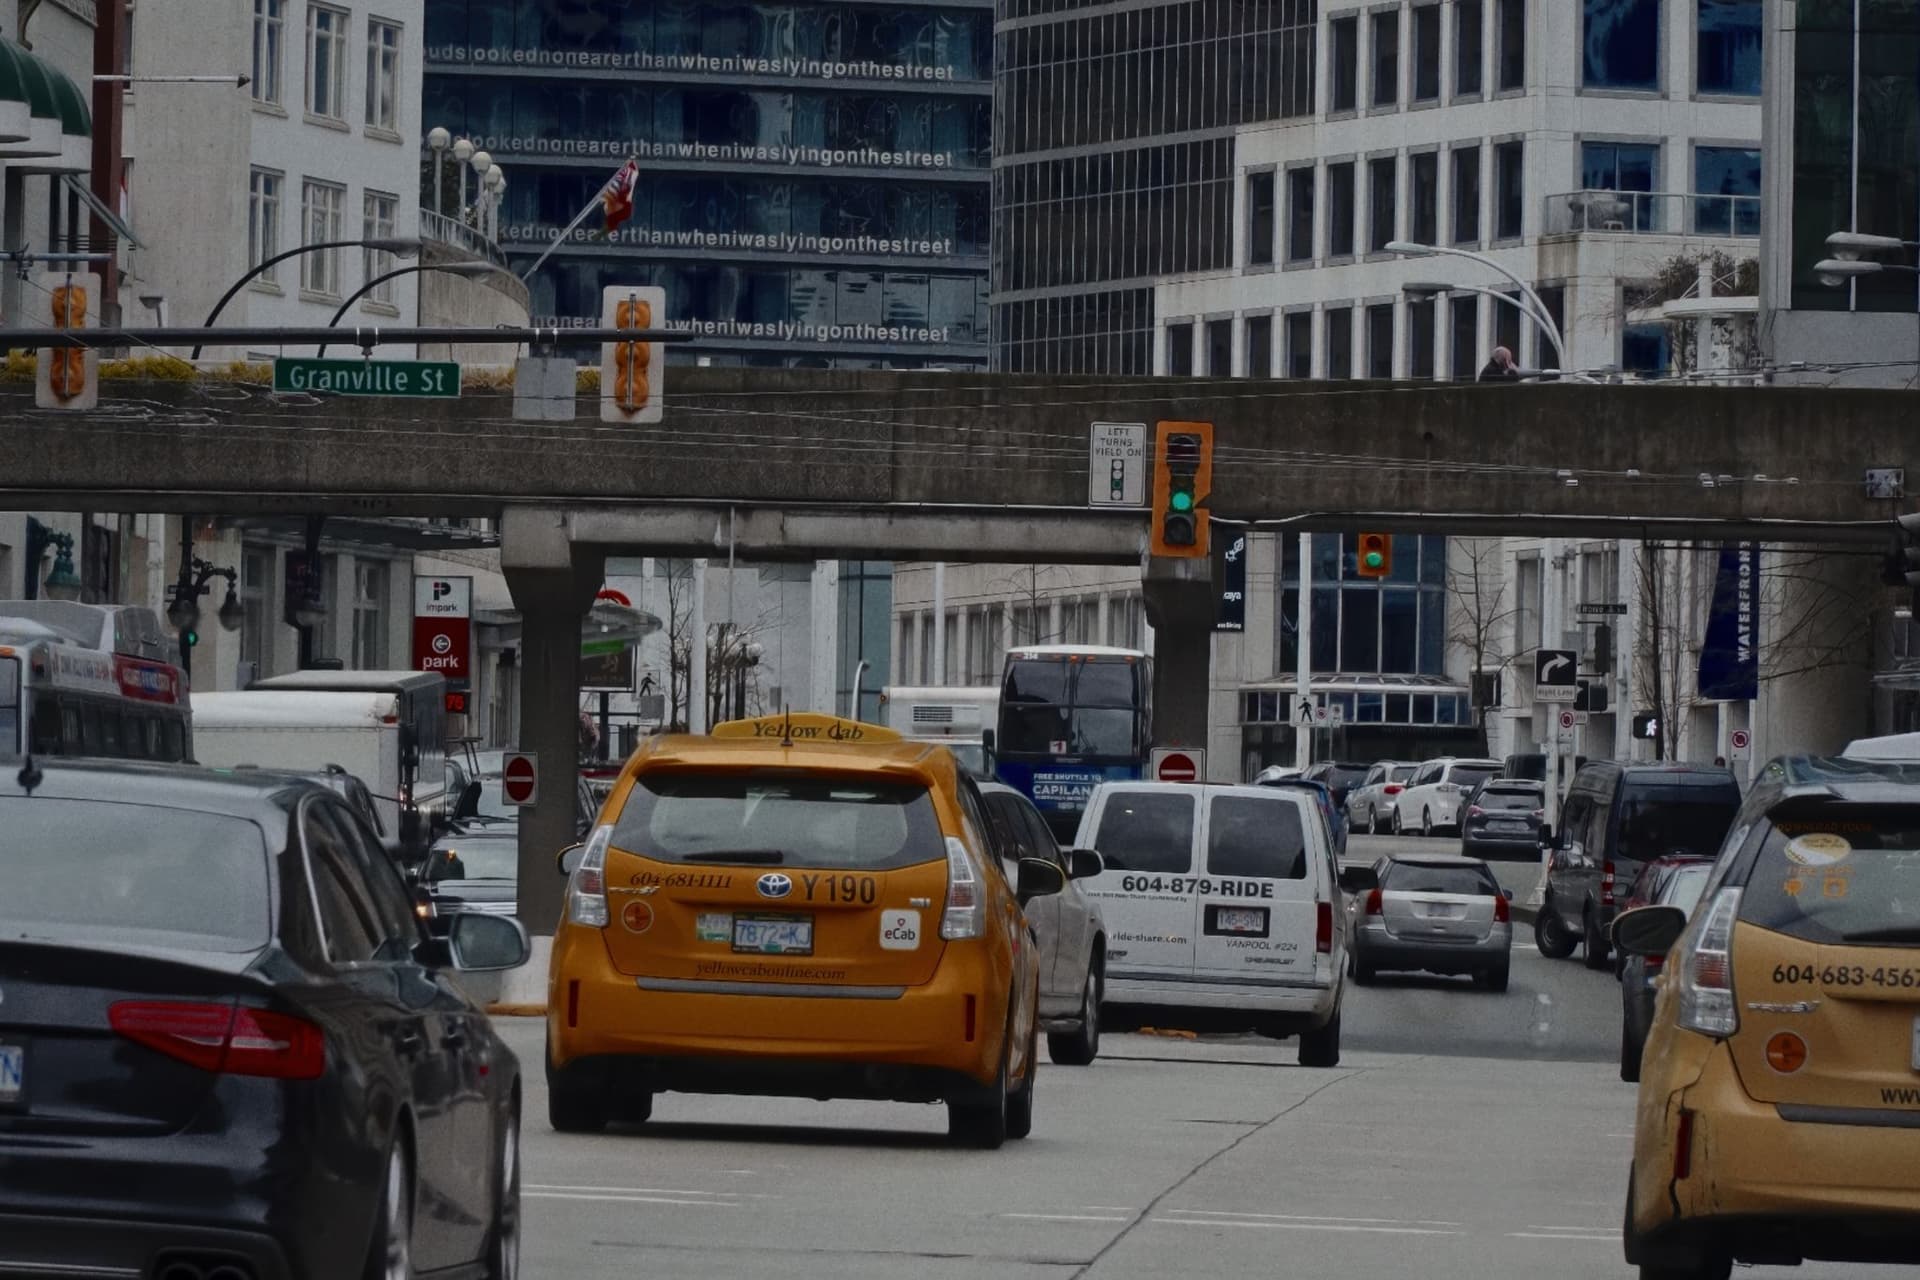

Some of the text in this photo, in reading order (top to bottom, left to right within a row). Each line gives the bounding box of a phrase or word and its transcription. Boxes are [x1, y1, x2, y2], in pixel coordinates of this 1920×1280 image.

[290, 365, 444, 392] Granville St
[1108, 427, 1129, 436] LEFT
[1100, 438, 1133, 447] TURNS
[1095, 447, 1142, 456] YIELD ON
[426, 602, 458, 613] impark
[422, 654, 460, 670] park
[754, 722, 863, 740] Yellow Cab
[1055, 773, 1089, 781] SHUTTLE
[630, 871, 732, 889] 604-681-1111
[802, 873, 875, 903] Y 190
[1122, 876, 1274, 898] 604-879-RIDE
[885, 928, 915, 941] eCab
[1112, 930, 1187, 946] ride-share.com
[1226, 939, 1298, 951] VANPOOL #224
[696, 962, 846, 979] yellowcabonline.com
